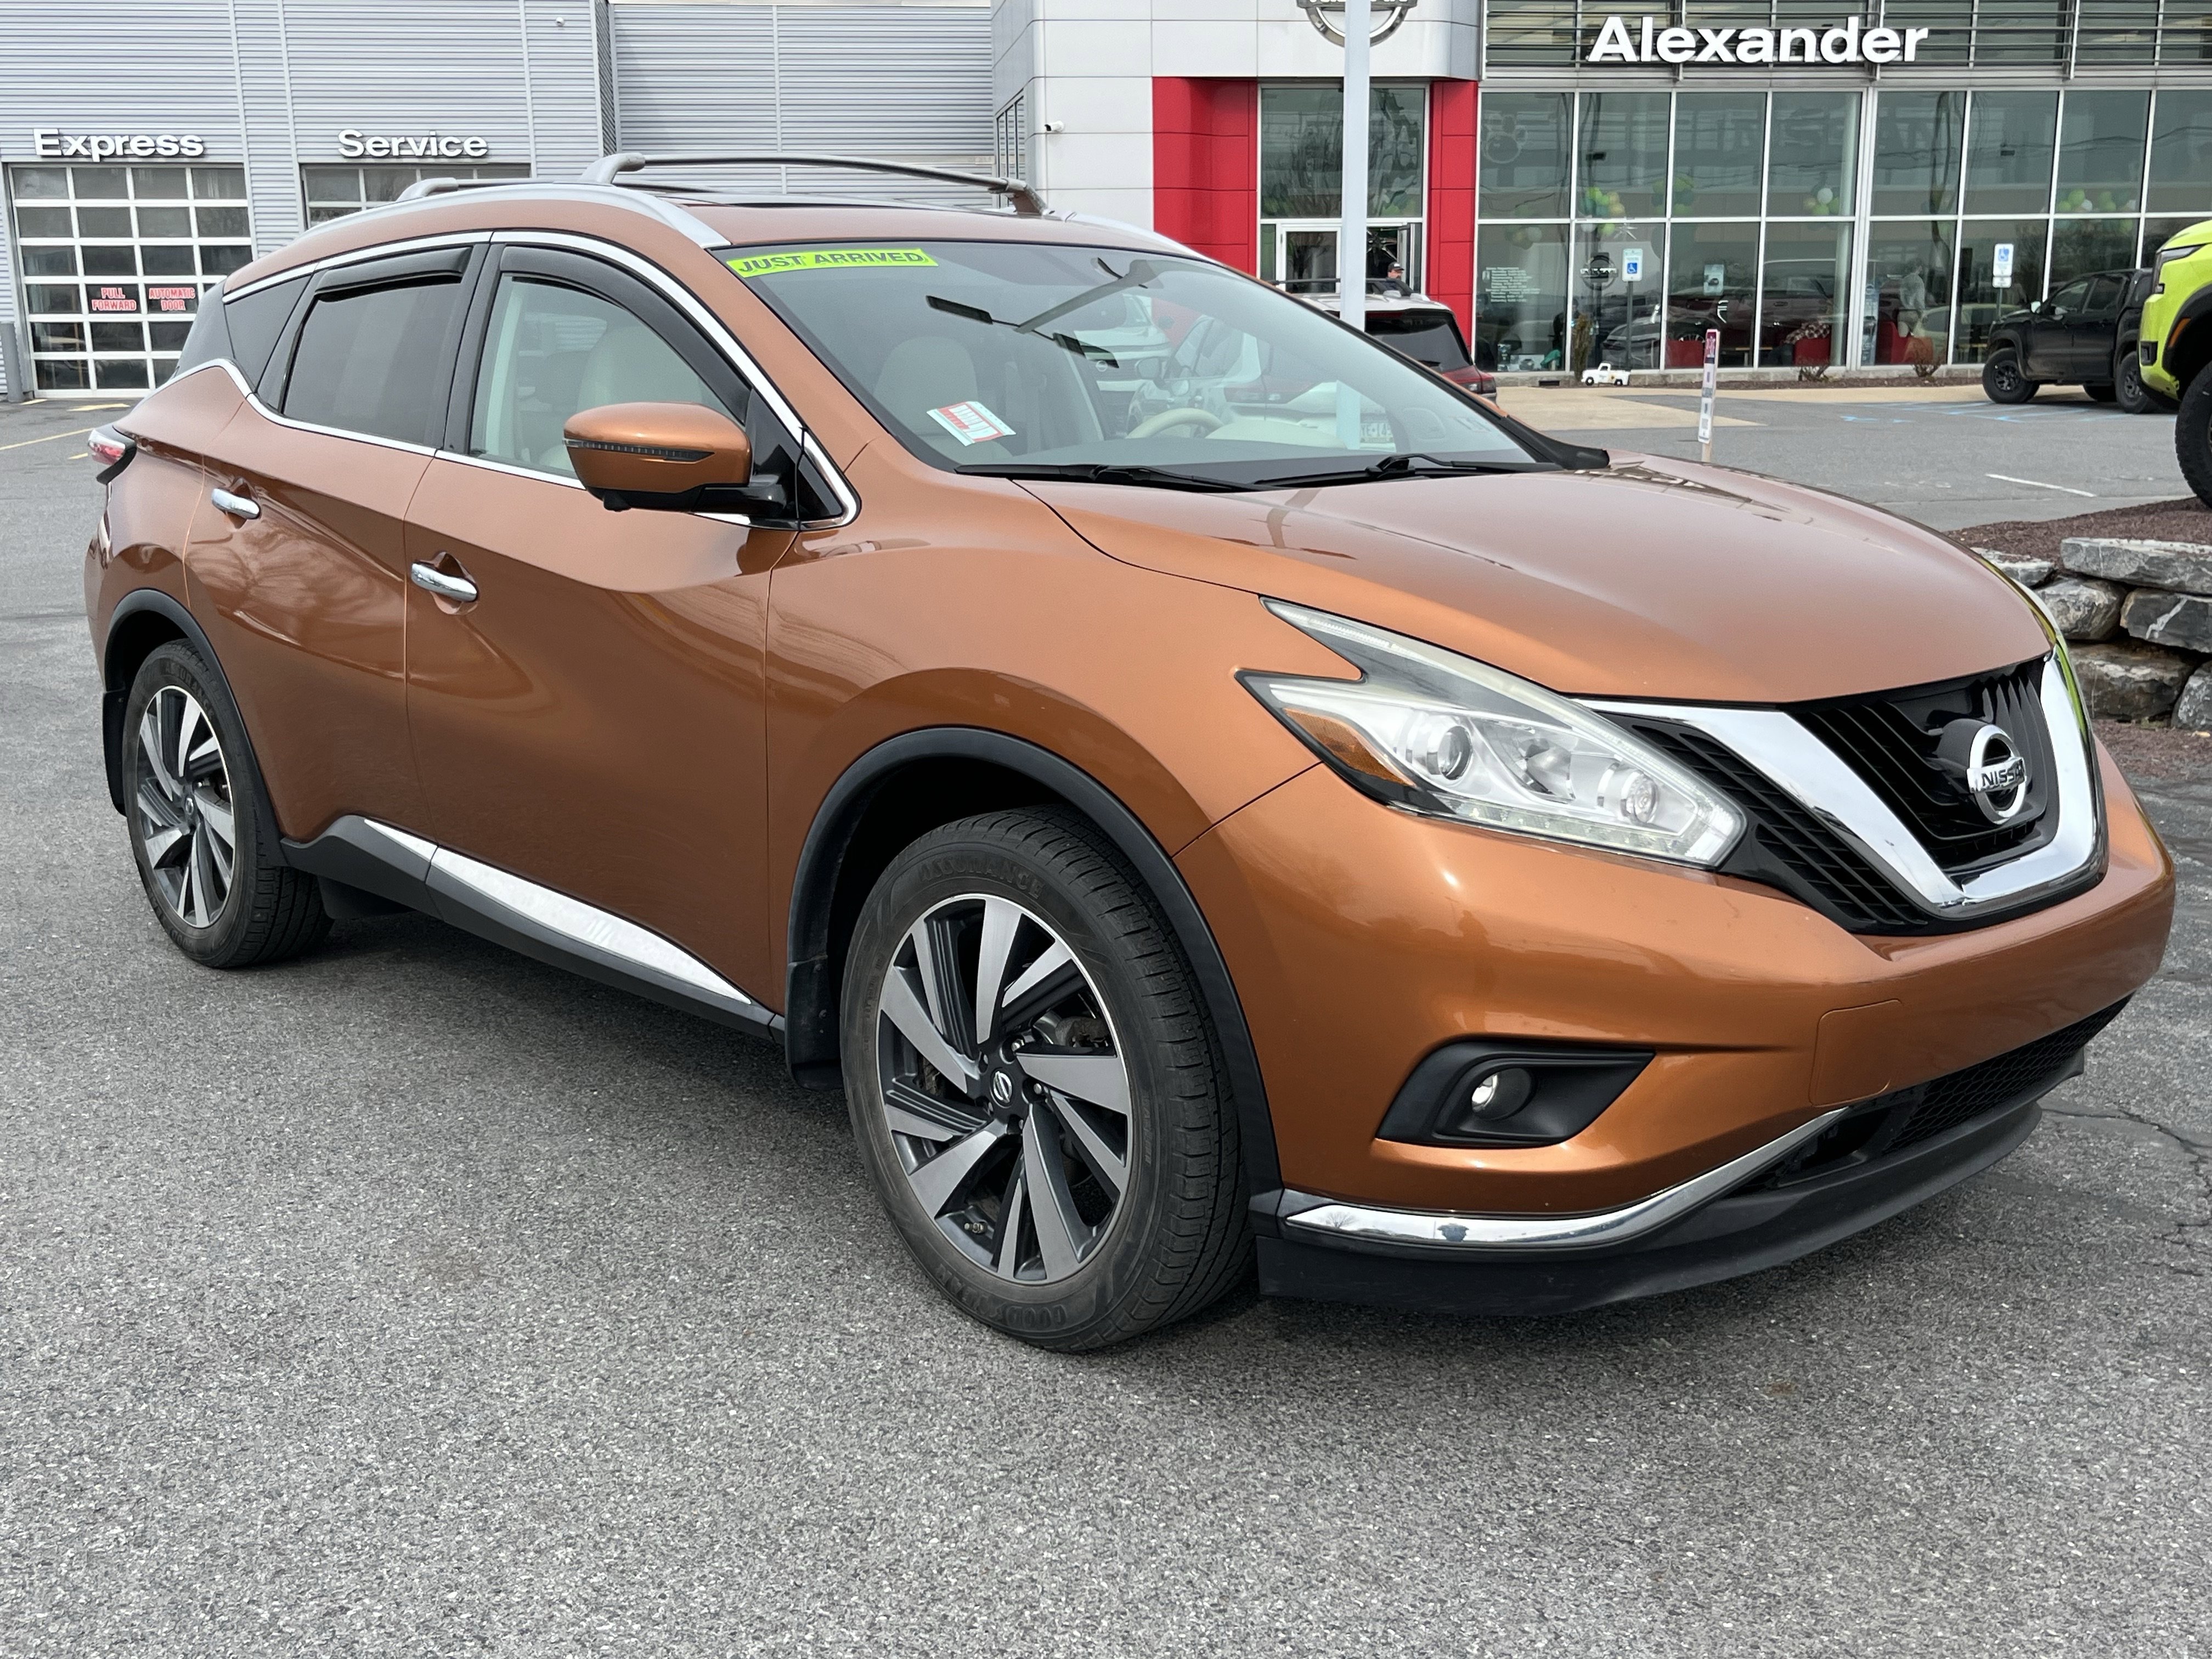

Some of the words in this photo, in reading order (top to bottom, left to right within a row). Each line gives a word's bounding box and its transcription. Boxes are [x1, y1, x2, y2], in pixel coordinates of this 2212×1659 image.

[1587, 16, 1928, 63] Alexander
[33, 128, 204, 162] Express
[338, 129, 488, 157] Service
[739, 255, 805, 272] JUST
[815, 252, 926, 264] ARRIVED
[100, 287, 126, 300] PULL
[149, 287, 196, 300] AUTOMATIC
[91, 299, 137, 311] FORWARD
[161, 300, 186, 311] DOOR
